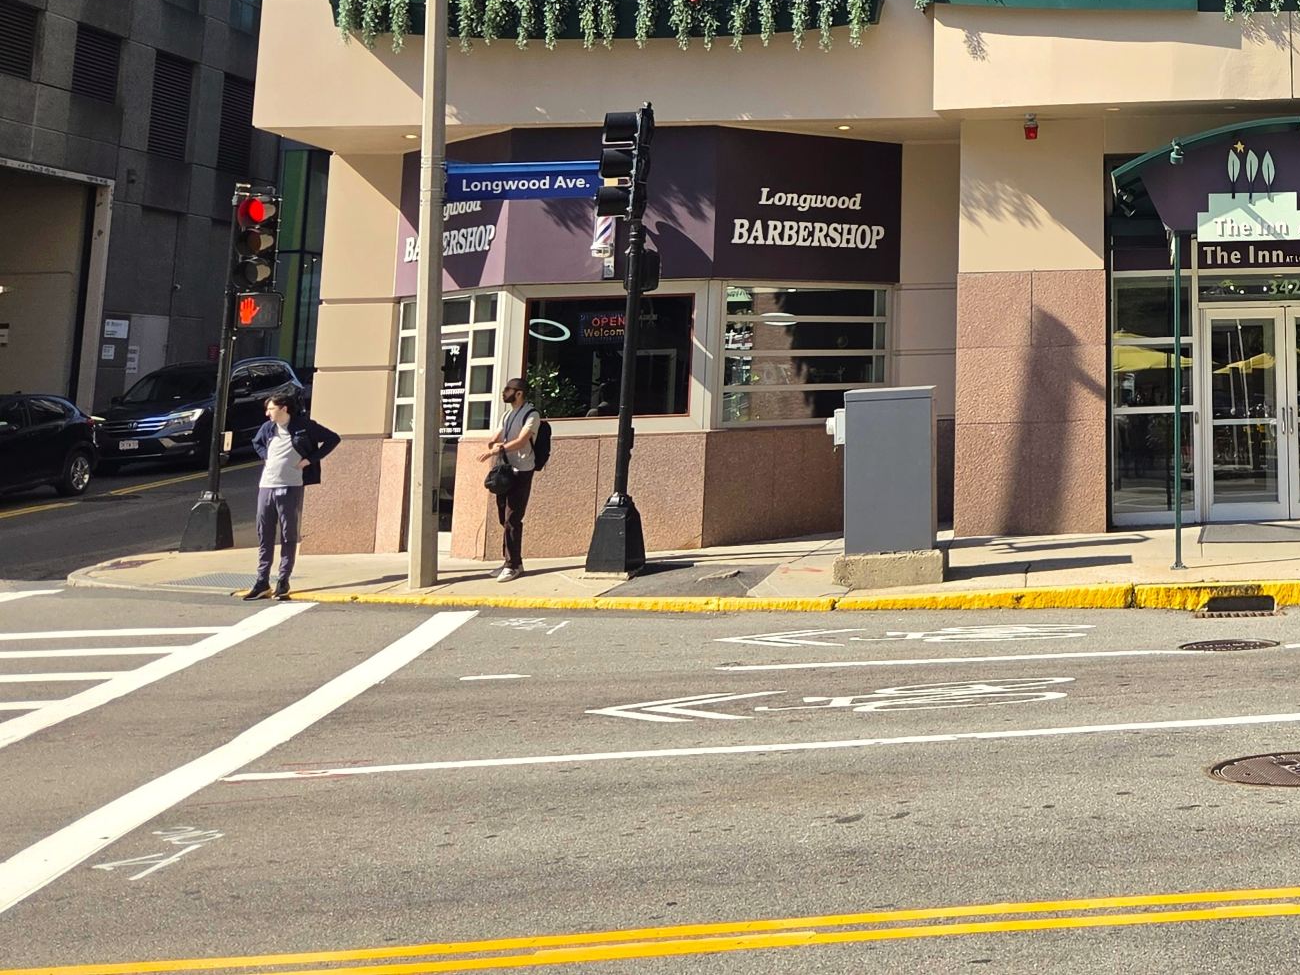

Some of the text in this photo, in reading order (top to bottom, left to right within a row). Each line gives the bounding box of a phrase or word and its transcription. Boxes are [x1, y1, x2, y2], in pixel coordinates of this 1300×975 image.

[462, 176, 590, 193] Longwood Ave.
[758, 187, 862, 212] Longwood
[731, 219, 885, 249] BARBERSHOP
[1213, 217, 1252, 237] The
[1257, 217, 1289, 236] Inn
[404, 225, 496, 263] BAERSHOP
[1203, 246, 1241, 264] The
[1248, 245, 1284, 263] Inn
[1285, 255, 1294, 263] AT
[592, 317, 625, 326] OPEN
[584, 328, 625, 337] Welcom
